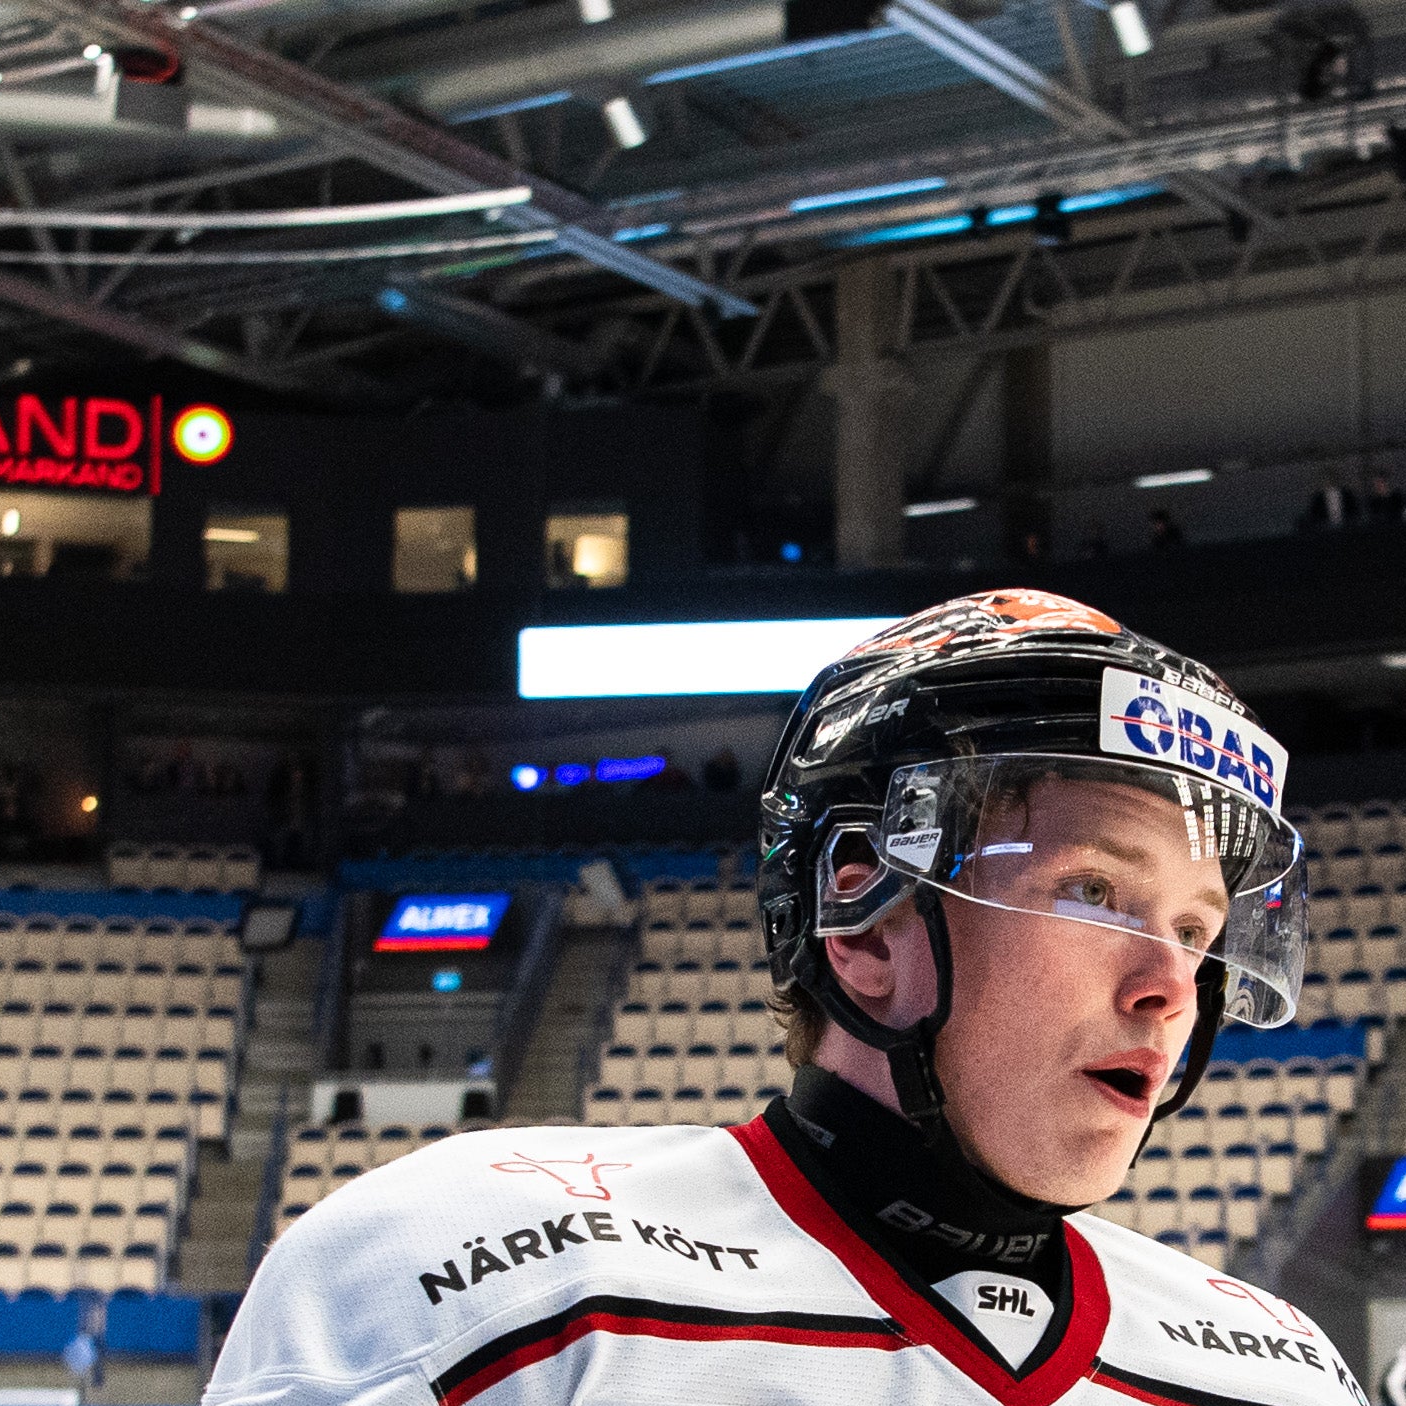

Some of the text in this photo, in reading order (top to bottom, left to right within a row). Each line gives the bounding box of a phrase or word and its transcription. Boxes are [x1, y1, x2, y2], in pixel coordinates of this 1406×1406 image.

[1123, 678, 1274, 809] ÖBAB
[889, 832, 940, 848] BAUER
[418, 1210, 760, 1306] NÄRKE KÖTT
[977, 1284, 1035, 1318] SHL
[1158, 1319, 1326, 1372] NÄRKE
